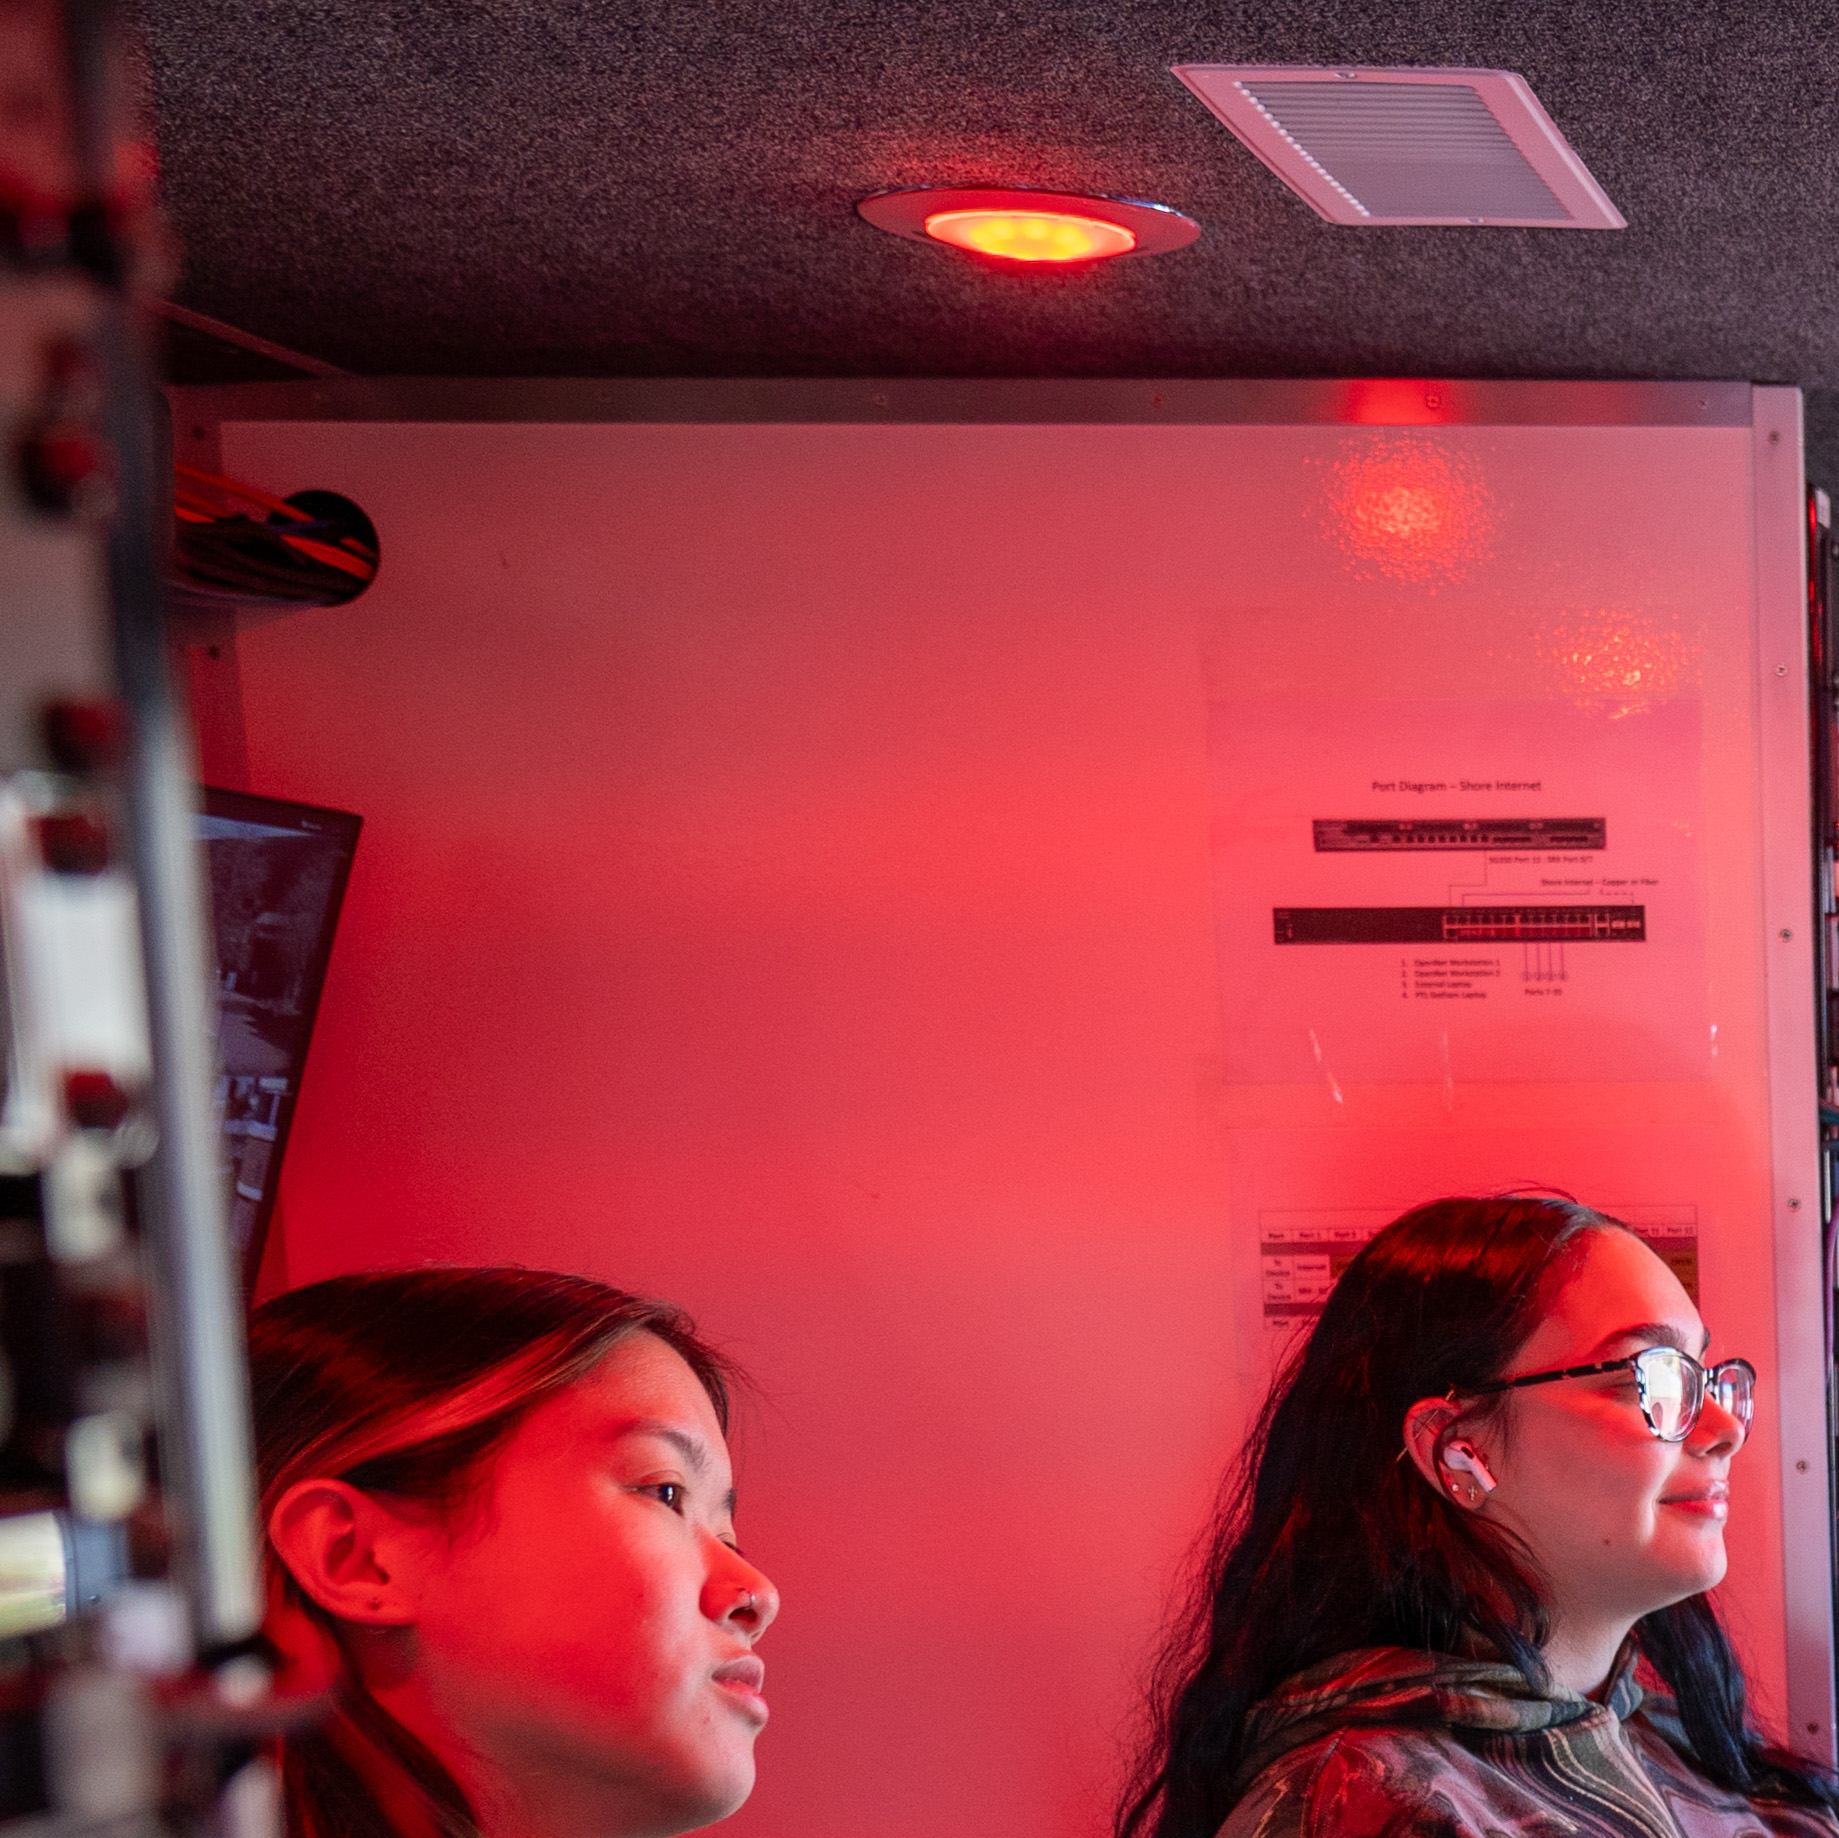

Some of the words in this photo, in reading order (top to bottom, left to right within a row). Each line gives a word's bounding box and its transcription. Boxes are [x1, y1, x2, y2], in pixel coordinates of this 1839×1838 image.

[1372, 781, 1395, 791] Port
[1399, 781, 1447, 794] Diagram
[1460, 781, 1492, 791] Shore
[1496, 781, 1542, 791] Internet
[1447, 981, 1472, 989] Laptop
